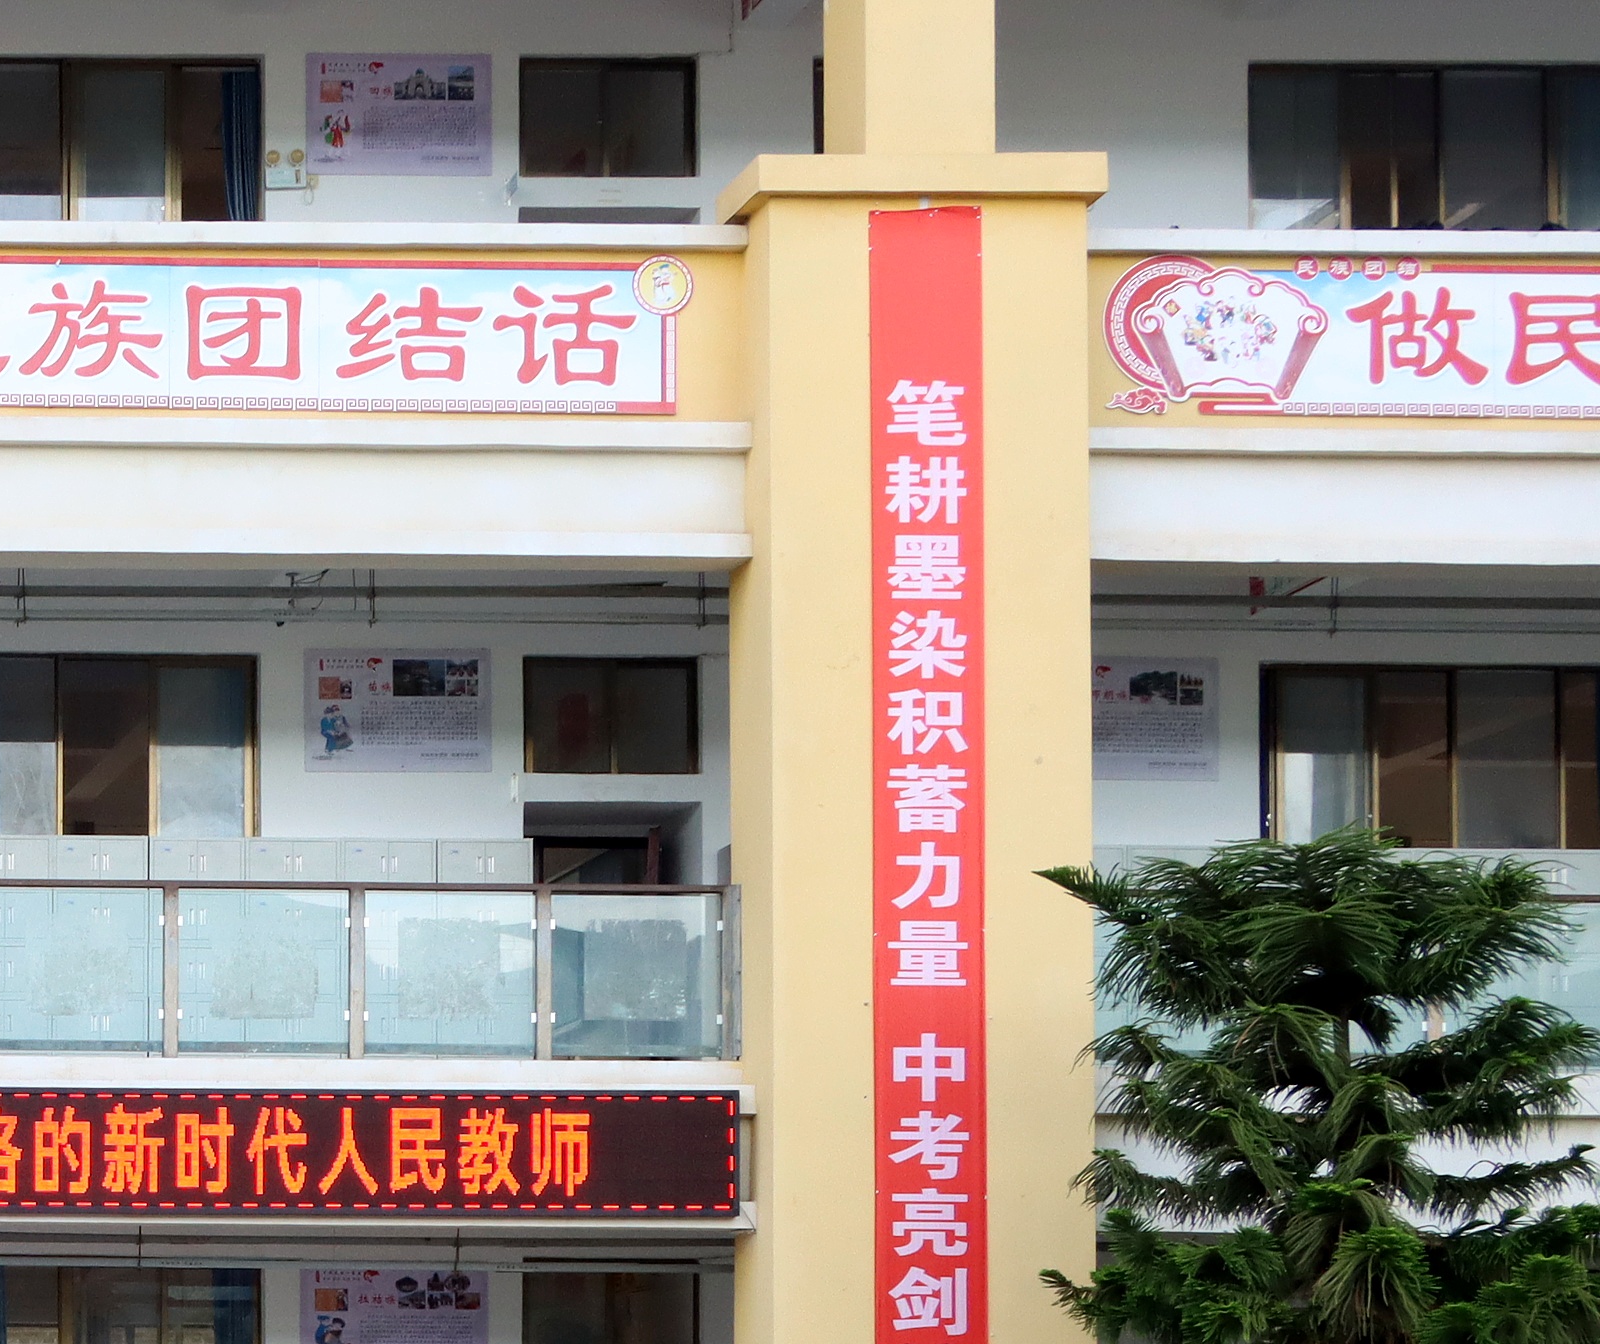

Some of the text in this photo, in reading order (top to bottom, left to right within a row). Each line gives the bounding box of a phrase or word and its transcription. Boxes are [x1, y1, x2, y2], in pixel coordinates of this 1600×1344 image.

[1296, 260, 1419, 276] 民族团结
[1346, 286, 1600, 386] 做民
[885, 379, 969, 986] 笔耕墨染积蓄力量
